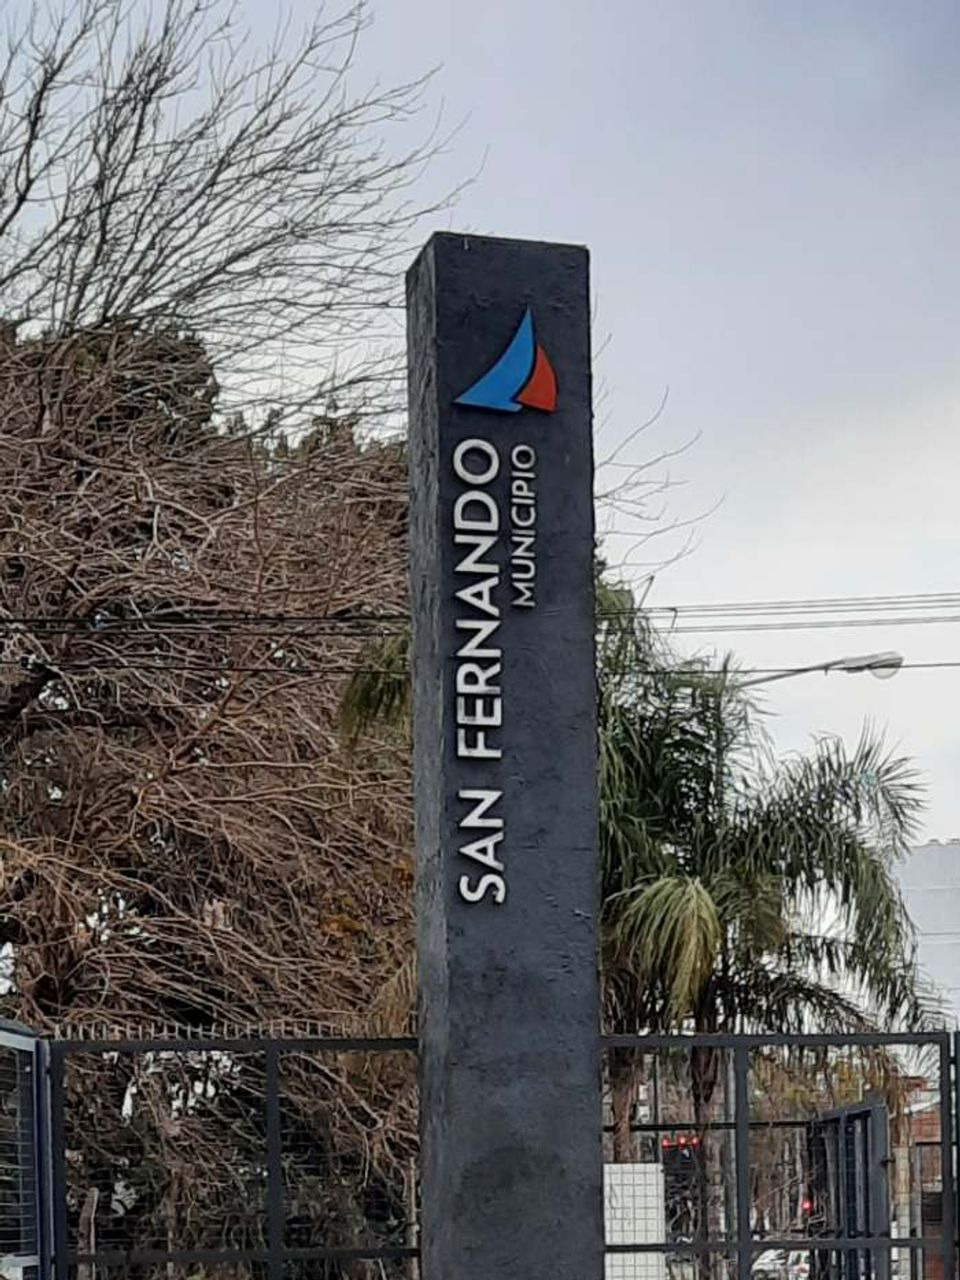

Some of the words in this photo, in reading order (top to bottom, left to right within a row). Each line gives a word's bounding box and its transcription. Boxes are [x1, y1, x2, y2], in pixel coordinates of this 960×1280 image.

[452, 438, 502, 759] FERNANDO
[510, 443, 536, 608] MUNICIPIO
[458, 788, 506, 904] SAN
